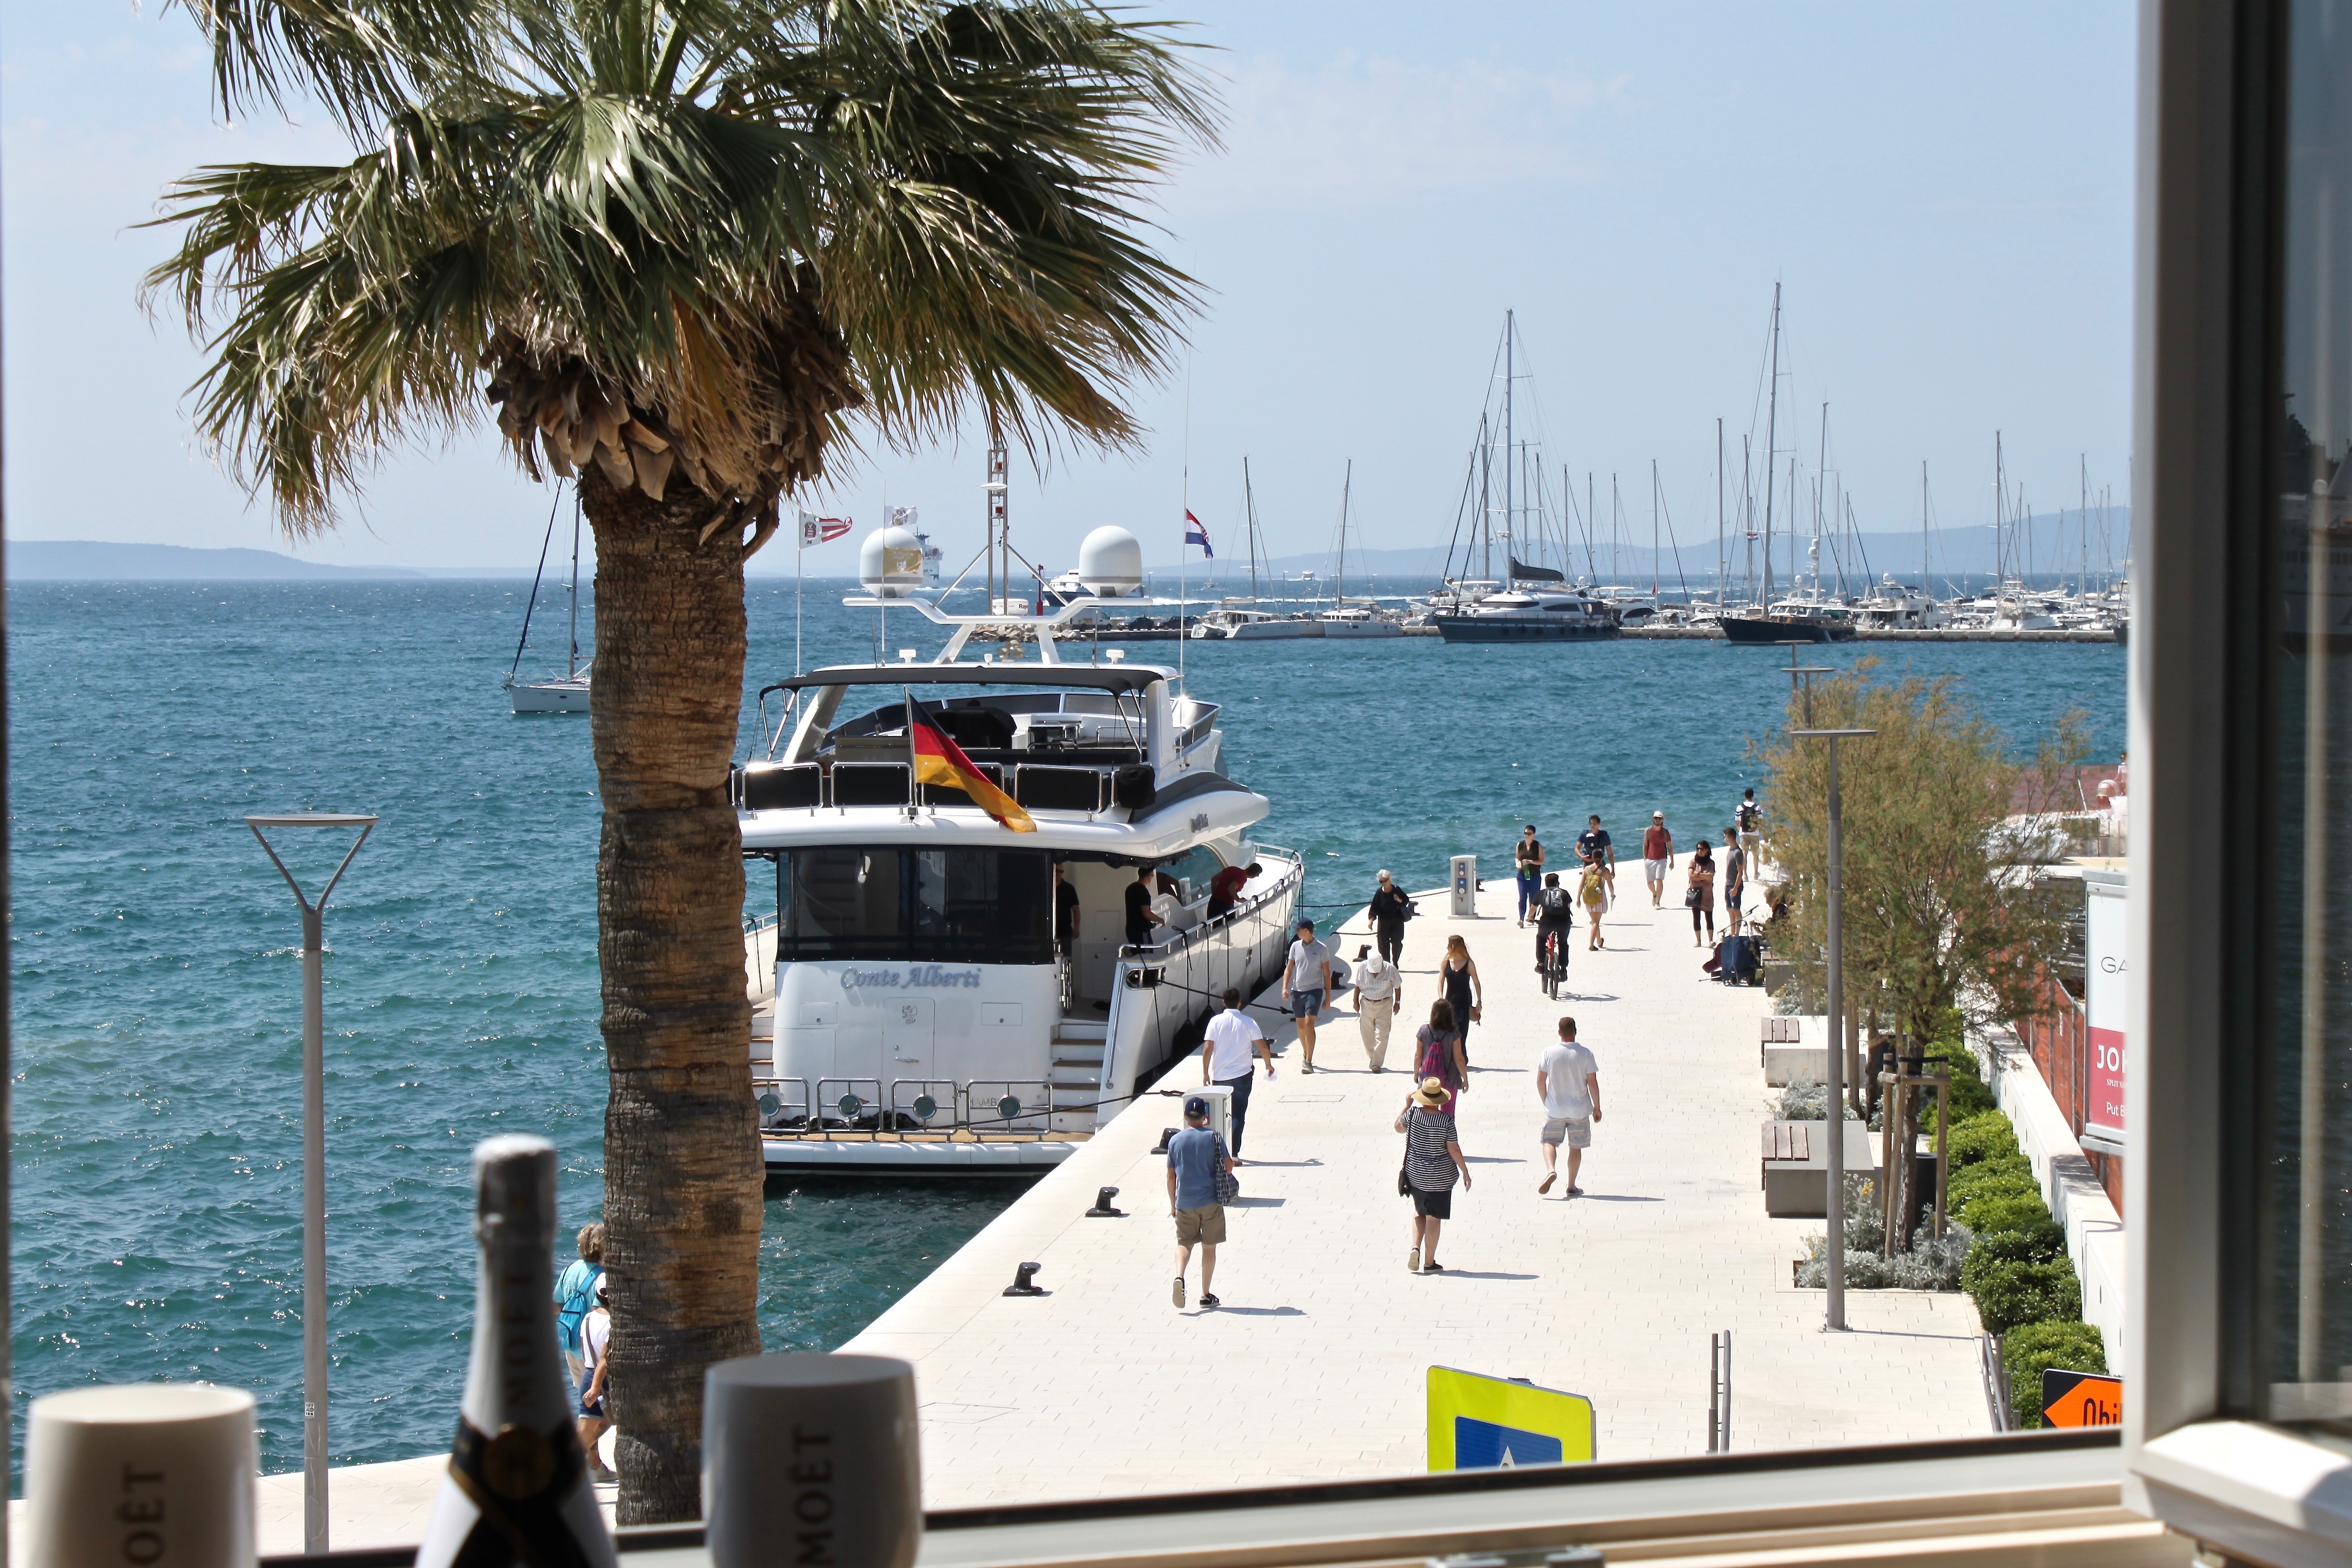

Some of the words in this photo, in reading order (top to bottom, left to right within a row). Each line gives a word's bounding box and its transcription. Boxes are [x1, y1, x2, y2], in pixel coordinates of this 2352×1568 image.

[840, 967, 900, 989] Conte
[901, 965, 981, 989] Alberti
[970, 1098, 999, 1106] HAMB
[2107, 1102, 2119, 1116] Put
